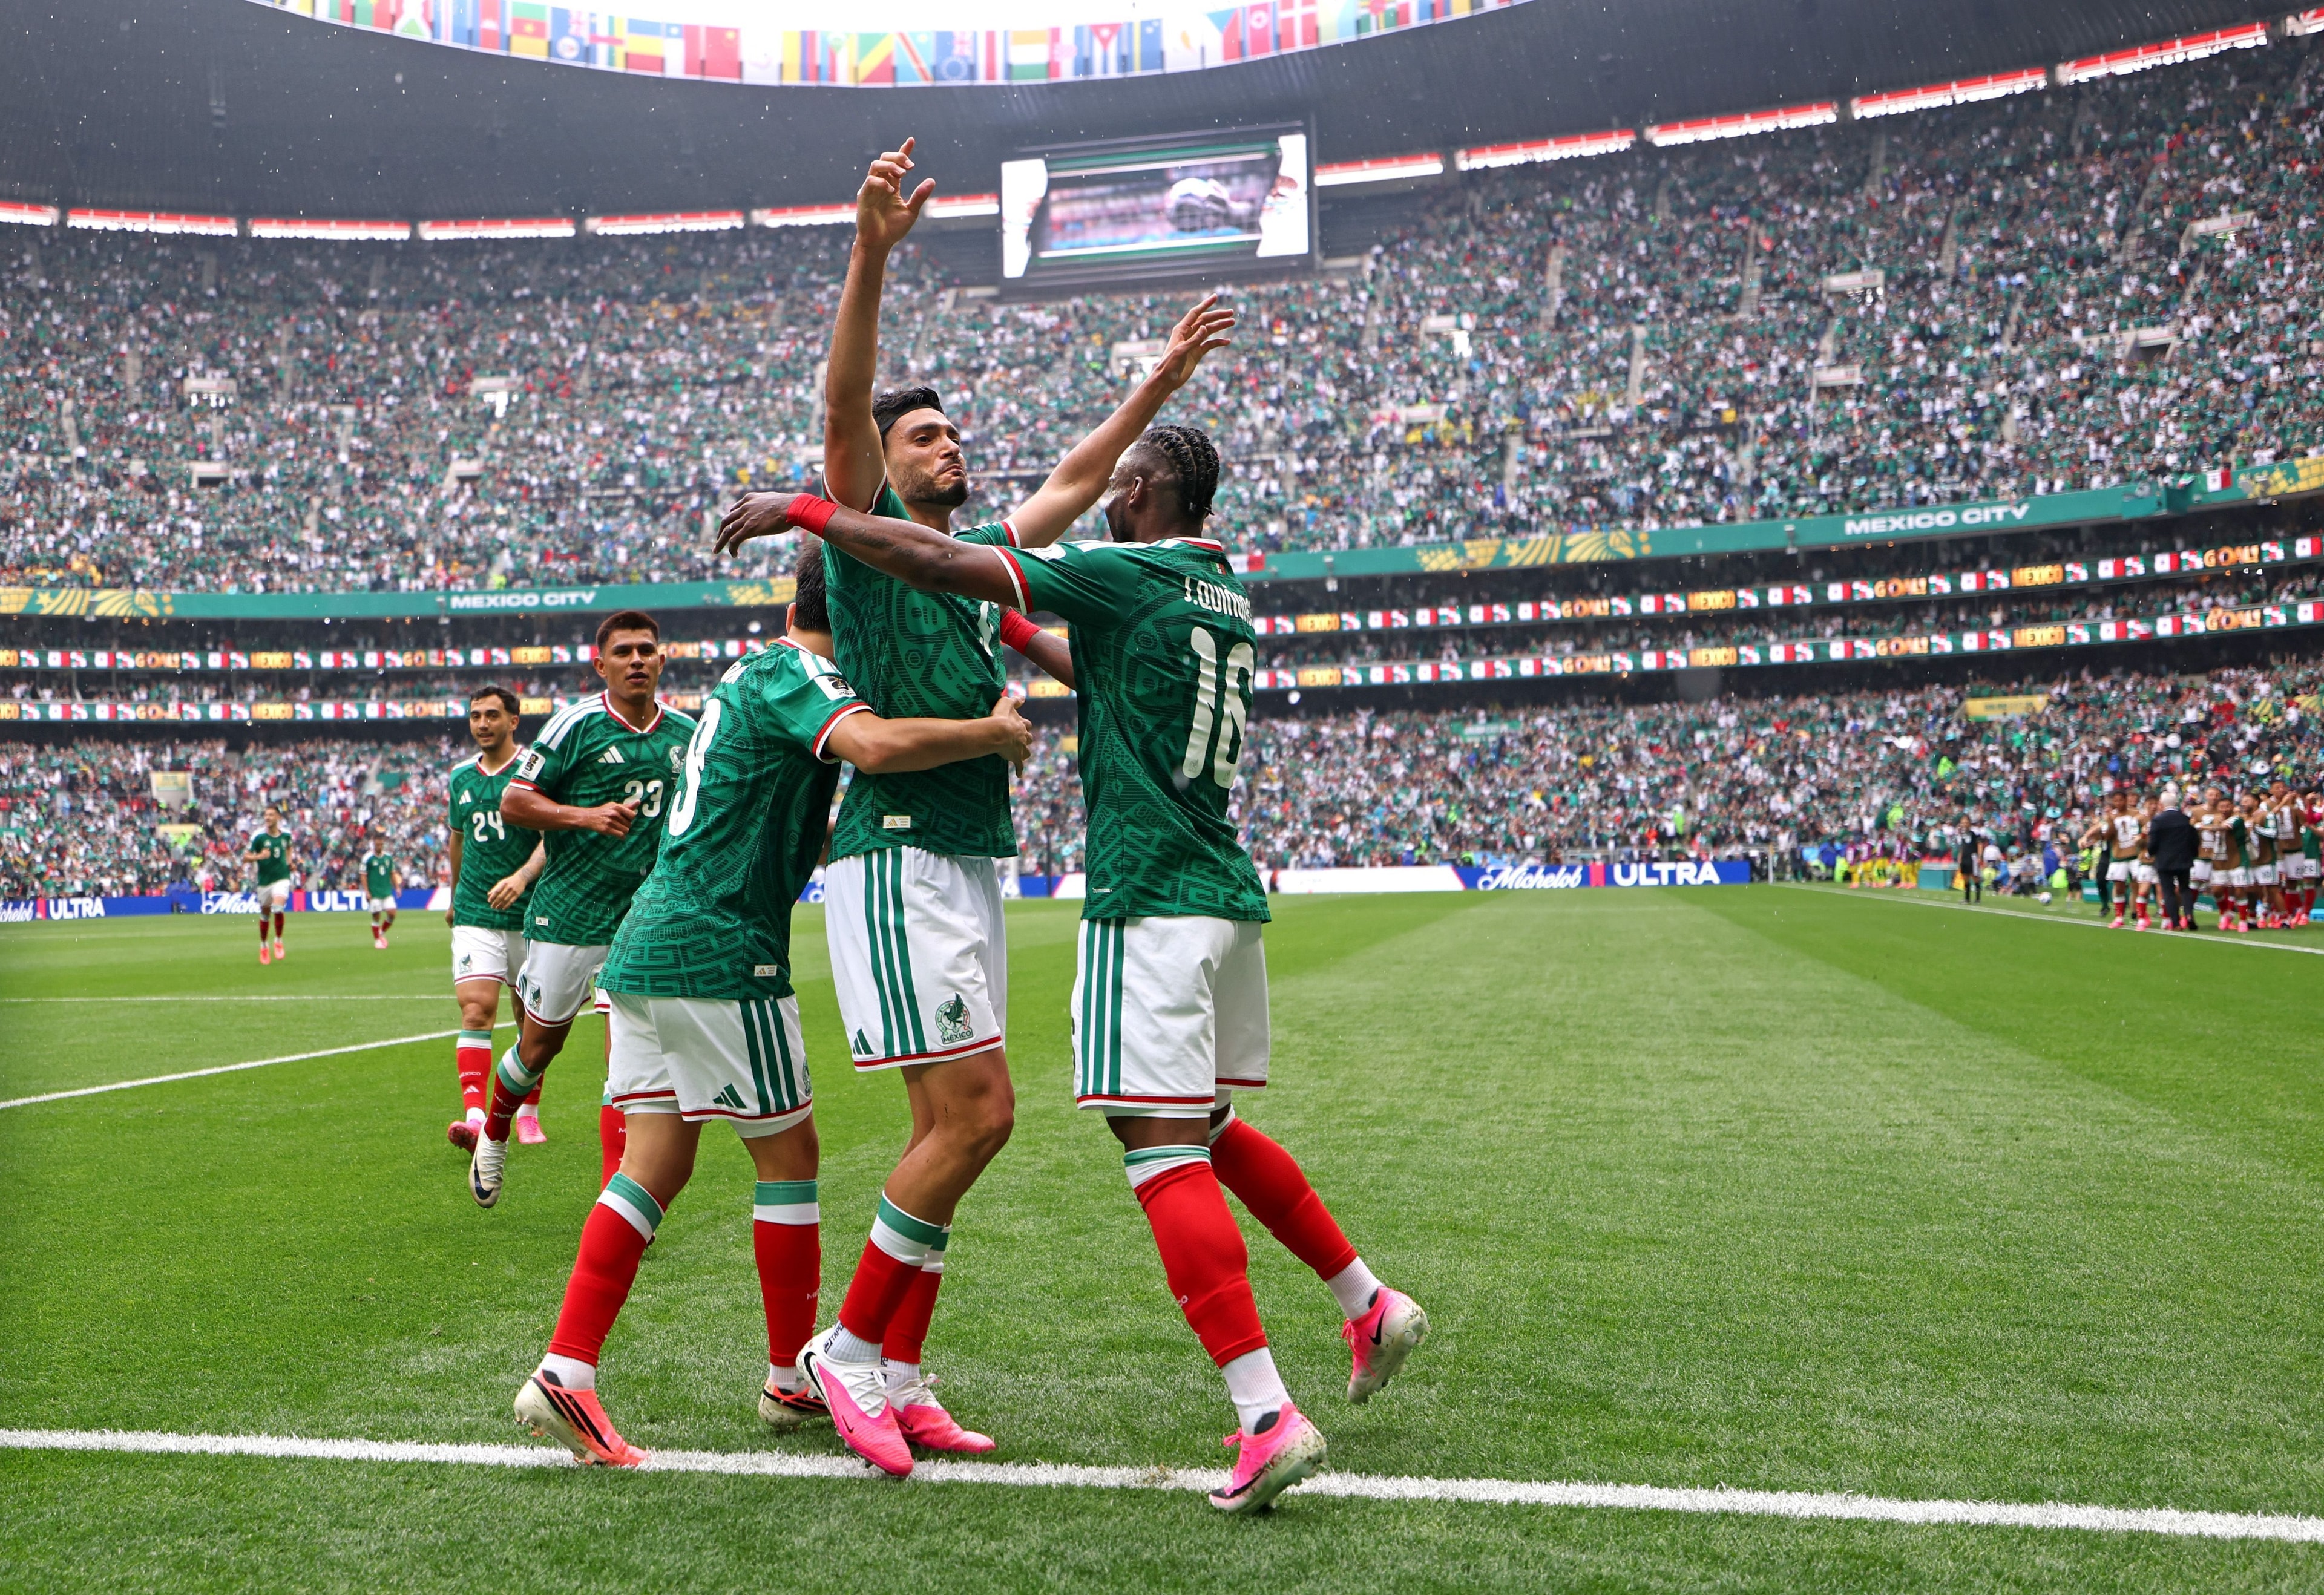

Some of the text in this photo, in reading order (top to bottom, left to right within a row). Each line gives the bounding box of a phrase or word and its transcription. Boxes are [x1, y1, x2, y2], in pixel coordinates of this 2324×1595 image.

[1845, 503, 2030, 535] MEXICO CITY
[450, 590, 596, 608] MEXICO CITY
[0, 650, 19, 667] ICO
[0, 703, 20, 719] ICO
[1182, 626, 1253, 789] 16
[623, 780, 664, 817] 23
[473, 811, 505, 842] 24
[1477, 861, 1721, 891] Michelob ULTRA
[0, 896, 105, 923] chelob ULTRA
[201, 891, 369, 914] Mich ULT
